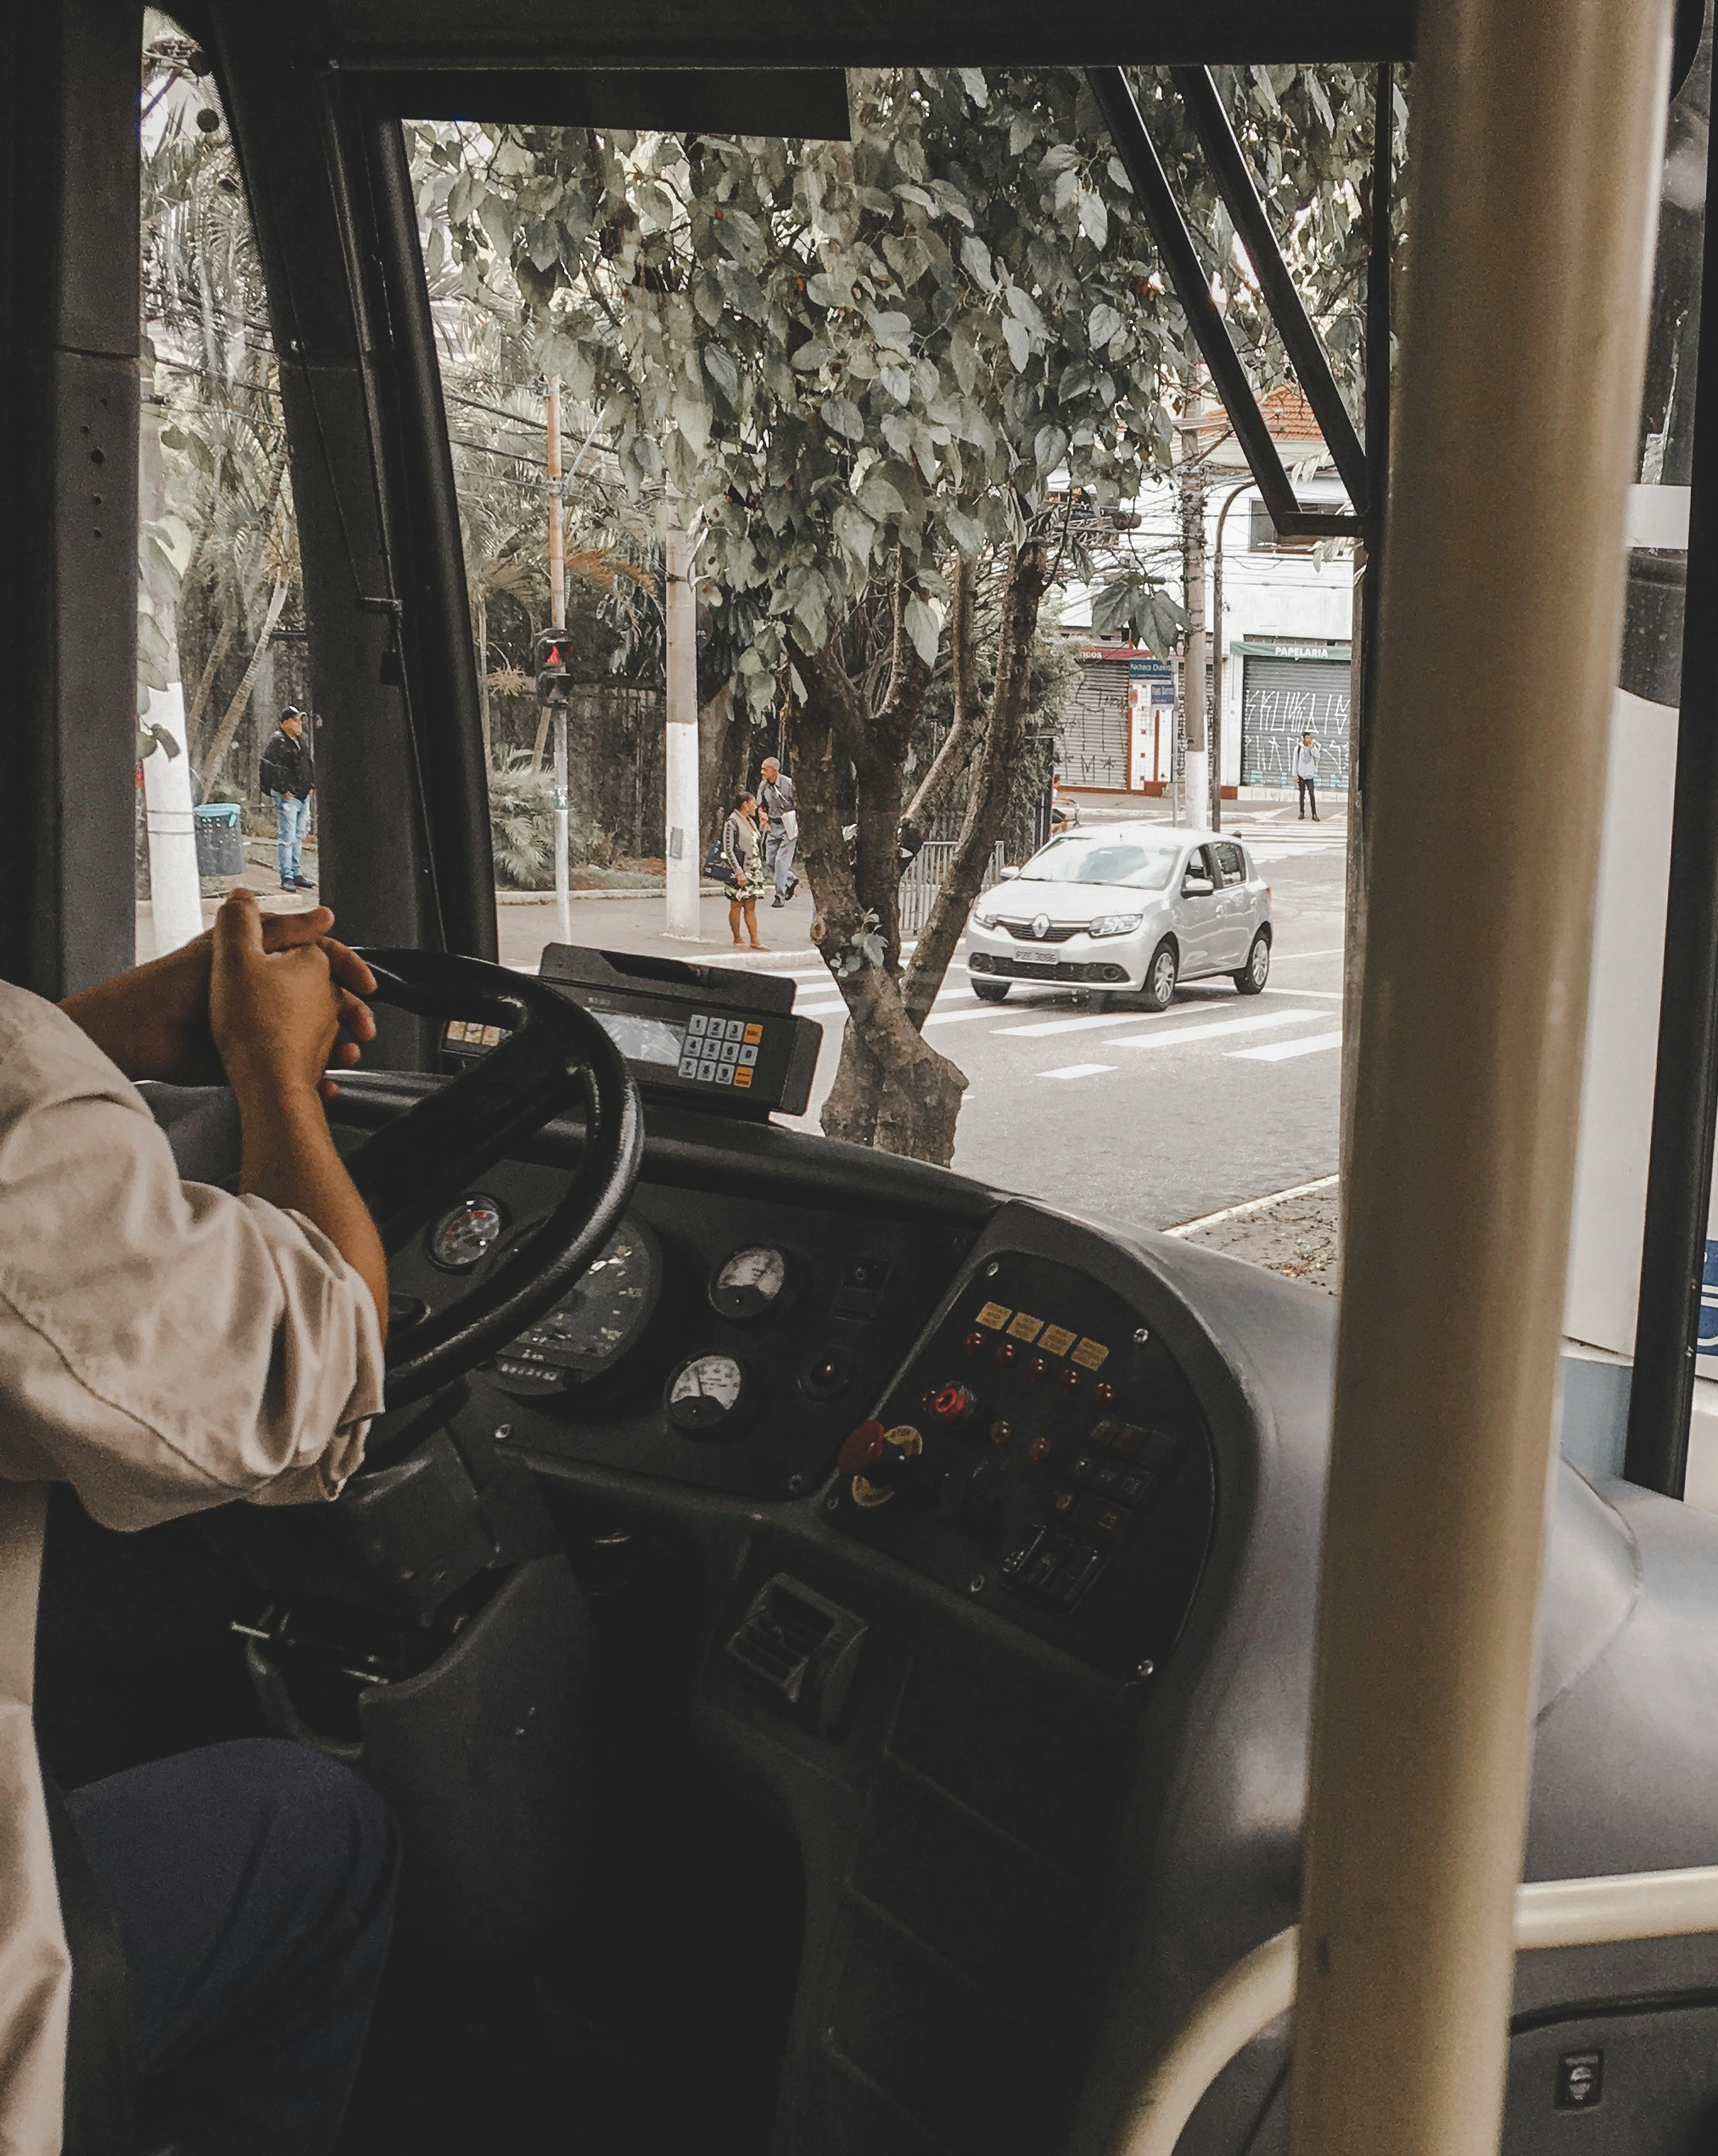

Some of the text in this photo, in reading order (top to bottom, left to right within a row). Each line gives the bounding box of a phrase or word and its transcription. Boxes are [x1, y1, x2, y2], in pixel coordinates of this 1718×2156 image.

[1275, 647, 1329, 658] PAPELARIA
[697, 1020, 702, 1028] 1
[713, 1022, 720, 1032] 2
[732, 1024, 738, 1033] 3
[691, 1040, 753, 1059] 4 5 6 0
[686, 1061, 692, 1071] 7
[703, 1065, 710, 1075] 8
[722, 1068, 729, 1078] 9
